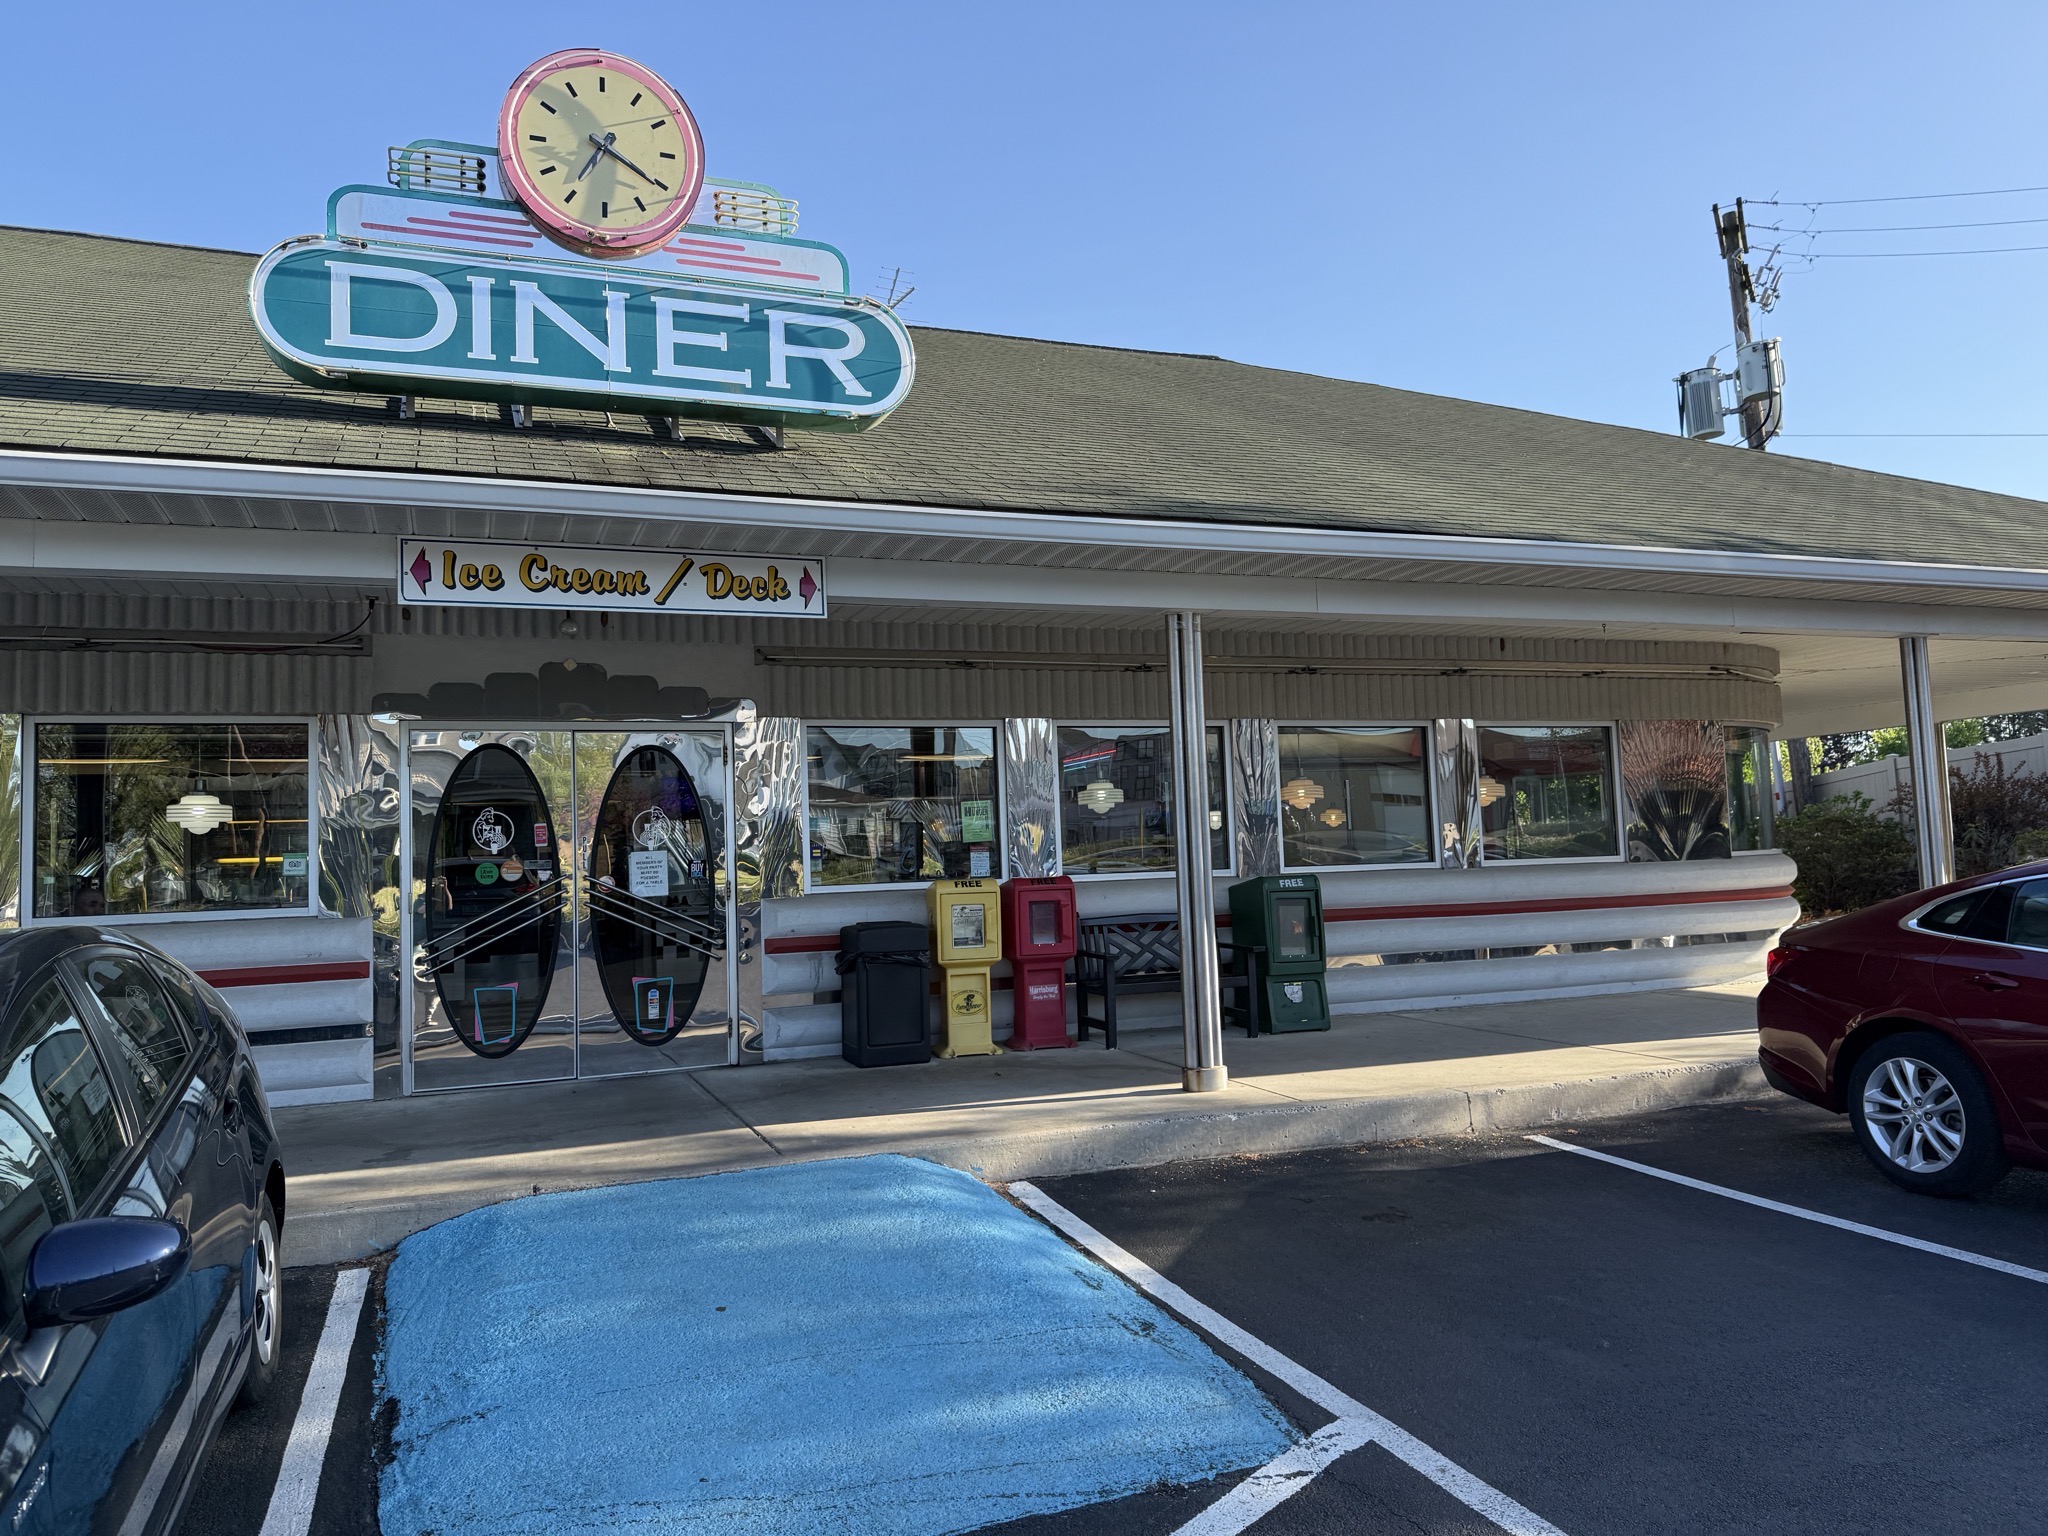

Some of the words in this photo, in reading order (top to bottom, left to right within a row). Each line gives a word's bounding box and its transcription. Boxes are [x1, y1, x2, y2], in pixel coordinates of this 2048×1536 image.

[324, 260, 872, 397] DINER
[441, 549, 505, 591] Ice
[518, 553, 650, 596] Cream
[700, 562, 791, 600] Deck
[691, 863, 704, 872] BUY
[954, 880, 982, 888] FREE
[1031, 878, 1057, 886] FREE
[1279, 878, 1304, 888] FREE
[1029, 985, 1058, 995] Harrisburg
